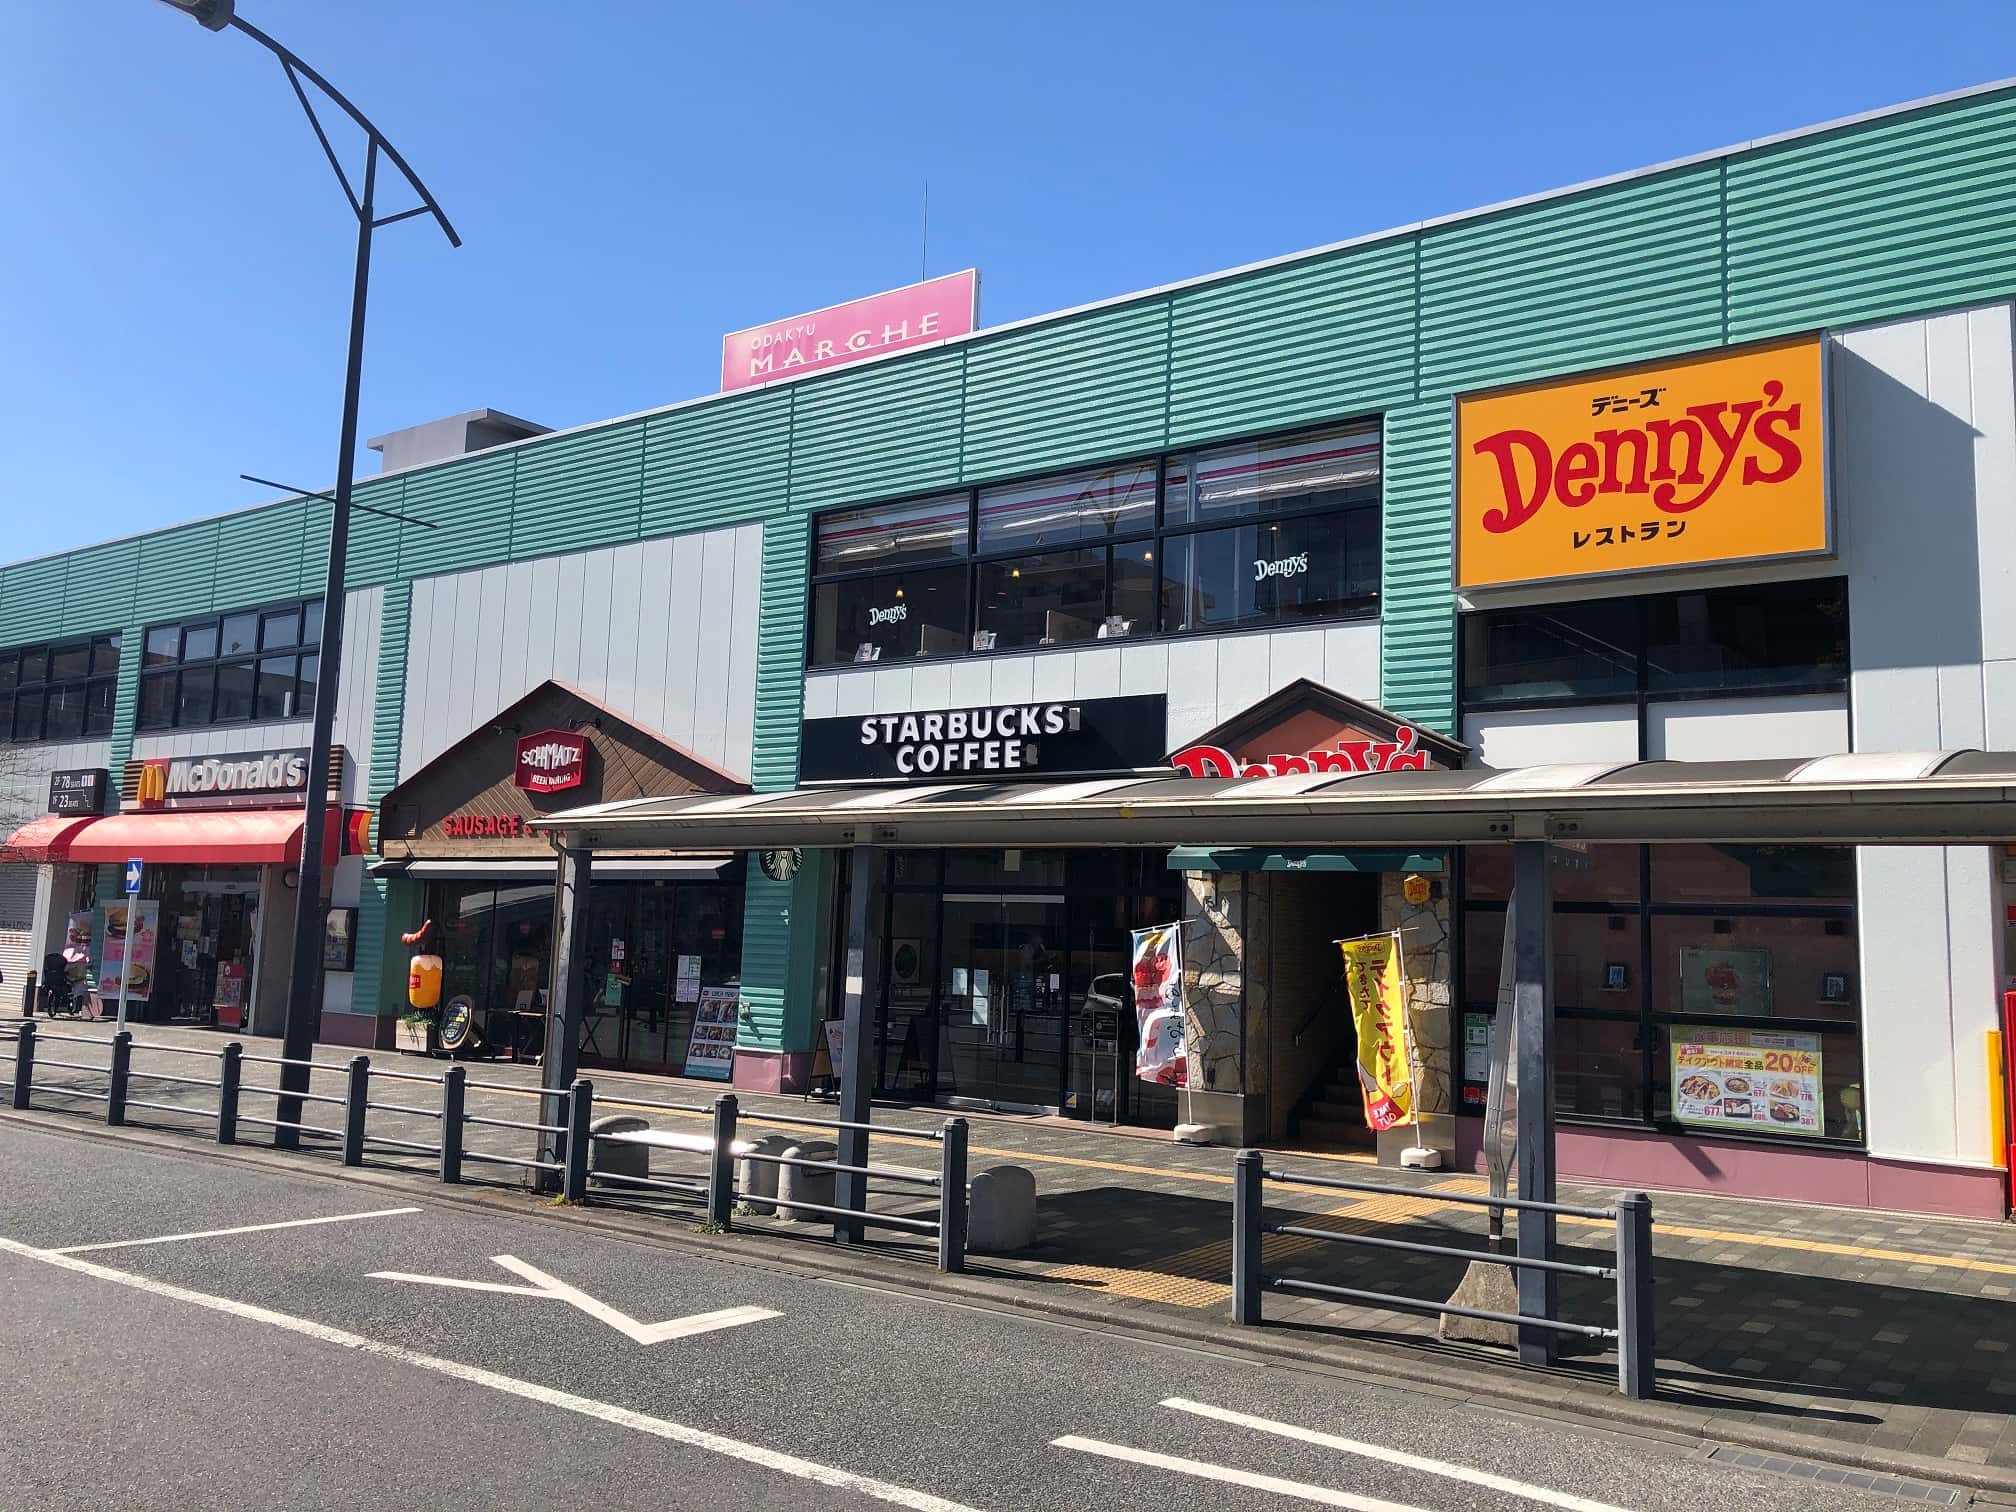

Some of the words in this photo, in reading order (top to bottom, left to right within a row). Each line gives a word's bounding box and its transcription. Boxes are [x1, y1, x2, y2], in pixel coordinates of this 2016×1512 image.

[750, 312, 940, 376] MARCHE
[751, 321, 816, 350] ODAKYU
[1591, 387, 1667, 416] デニーズ
[1473, 379, 1802, 534] Denny's
[1573, 520, 1687, 549] レストラン
[1253, 551, 1308, 581] Denny's
[868, 602, 908, 626] Denny's
[861, 705, 1064, 745] STARBUCKS
[521, 743, 582, 770] SCHMATZ
[895, 739, 1022, 774] COFFEE
[1171, 726, 1427, 778] Dnny'
[61, 775, 71, 789] 78
[166, 753, 306, 793] McDonald's
[59, 794, 69, 808] 23
[444, 814, 521, 837] SAUSAGE
[1765, 1052, 1793, 1073] 20
